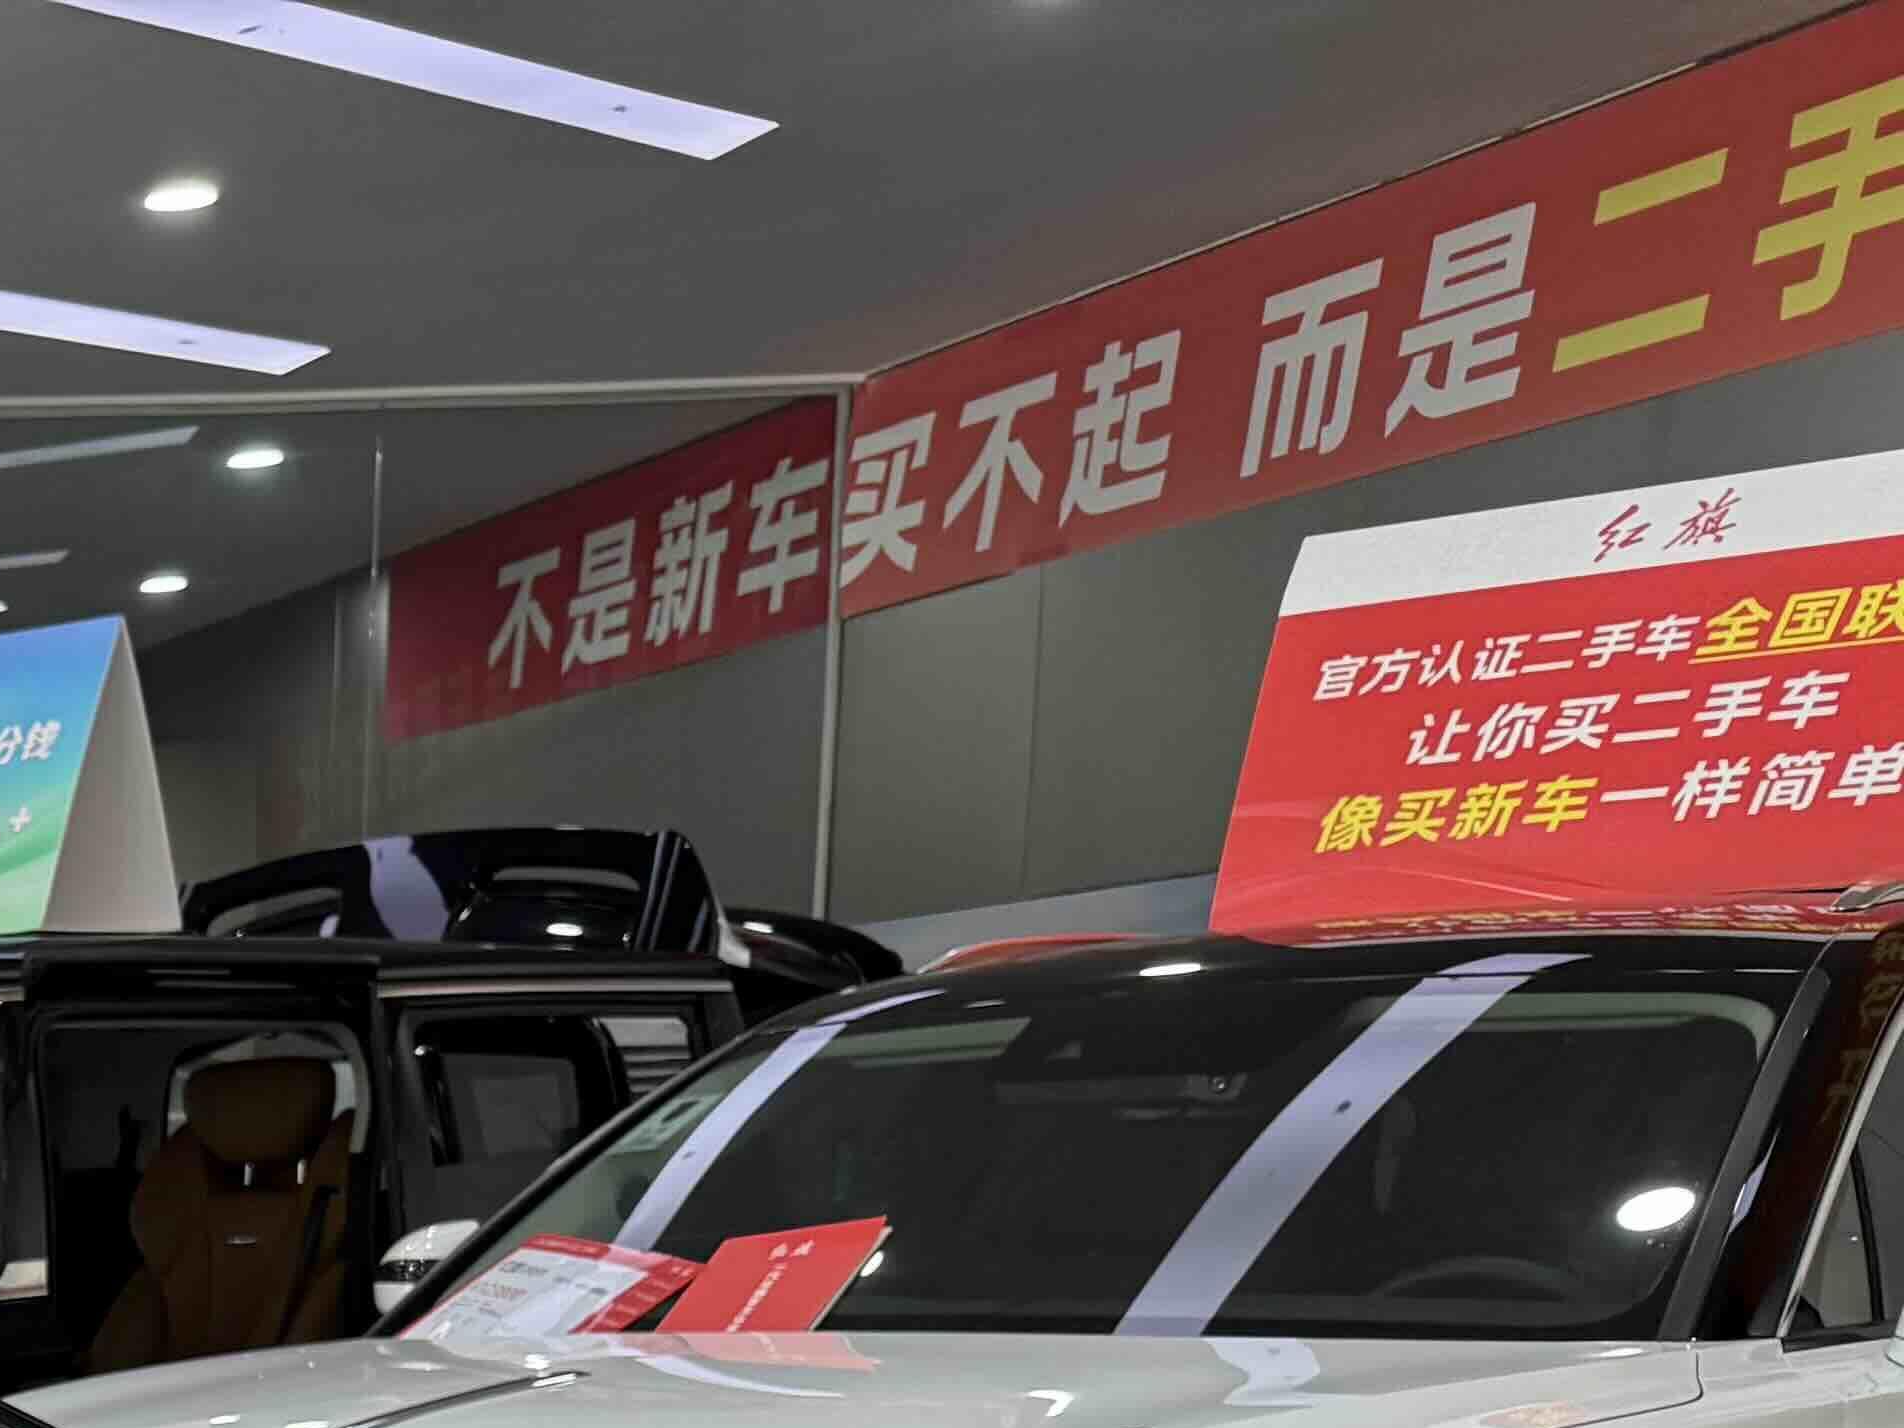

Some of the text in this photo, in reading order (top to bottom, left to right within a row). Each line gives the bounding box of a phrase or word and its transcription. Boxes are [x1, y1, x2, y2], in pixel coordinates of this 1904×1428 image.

[487, 75, 1904, 690] 不是新车买不起 而是二手
[1593, 488, 1742, 563] 红旗
[1405, 670, 1850, 766] 让你买二手车
[1313, 742, 1904, 855] 像买新车一样简单
